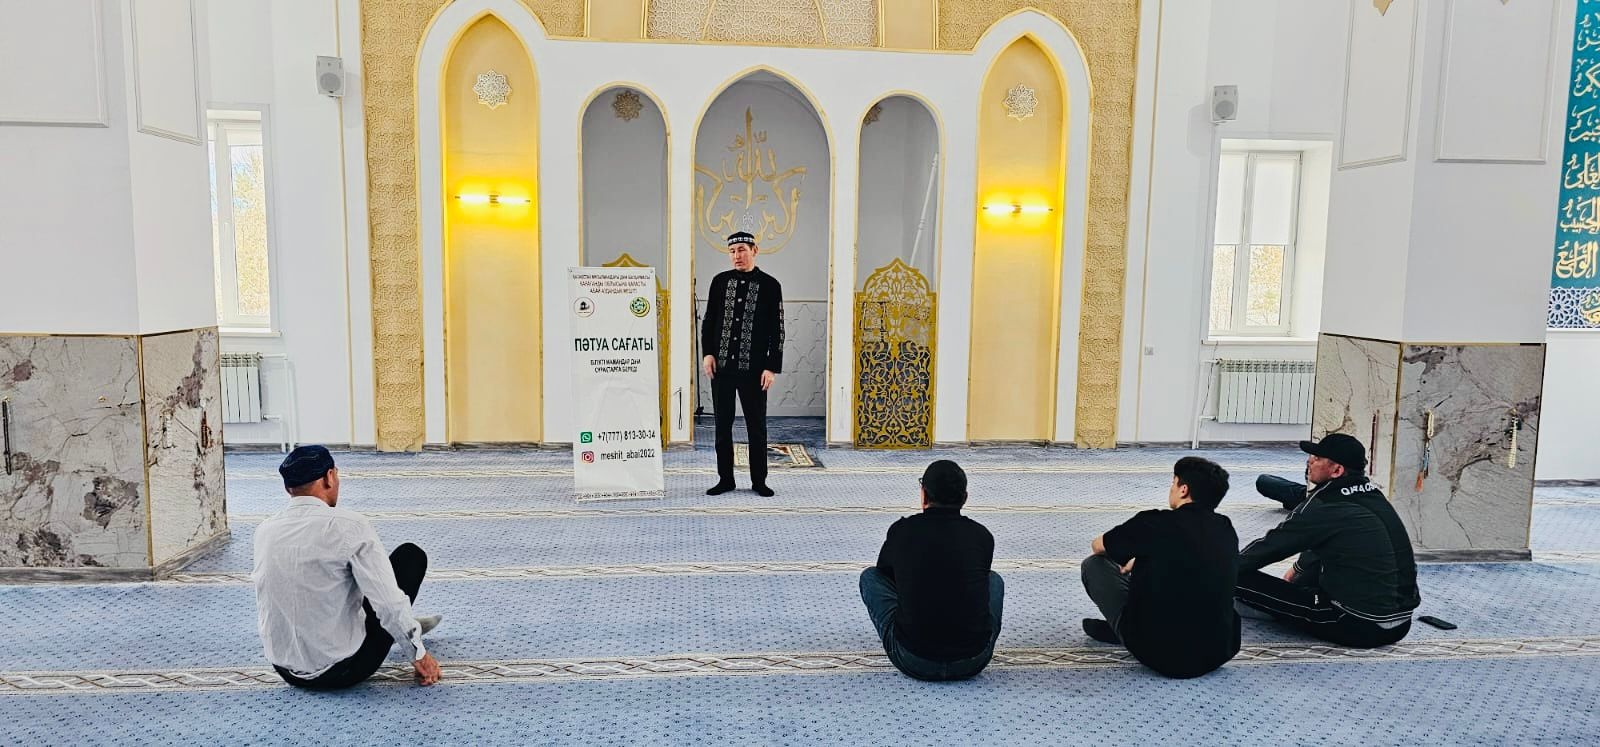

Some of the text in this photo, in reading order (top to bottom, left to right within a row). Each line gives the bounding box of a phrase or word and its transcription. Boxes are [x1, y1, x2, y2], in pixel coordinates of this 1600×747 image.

[574, 337, 654, 352] ПӘТУА САҒАТЫ
[597, 430, 656, 443] +7(777) 813-30-34
[600, 448, 655, 462] meshit_abai2022
